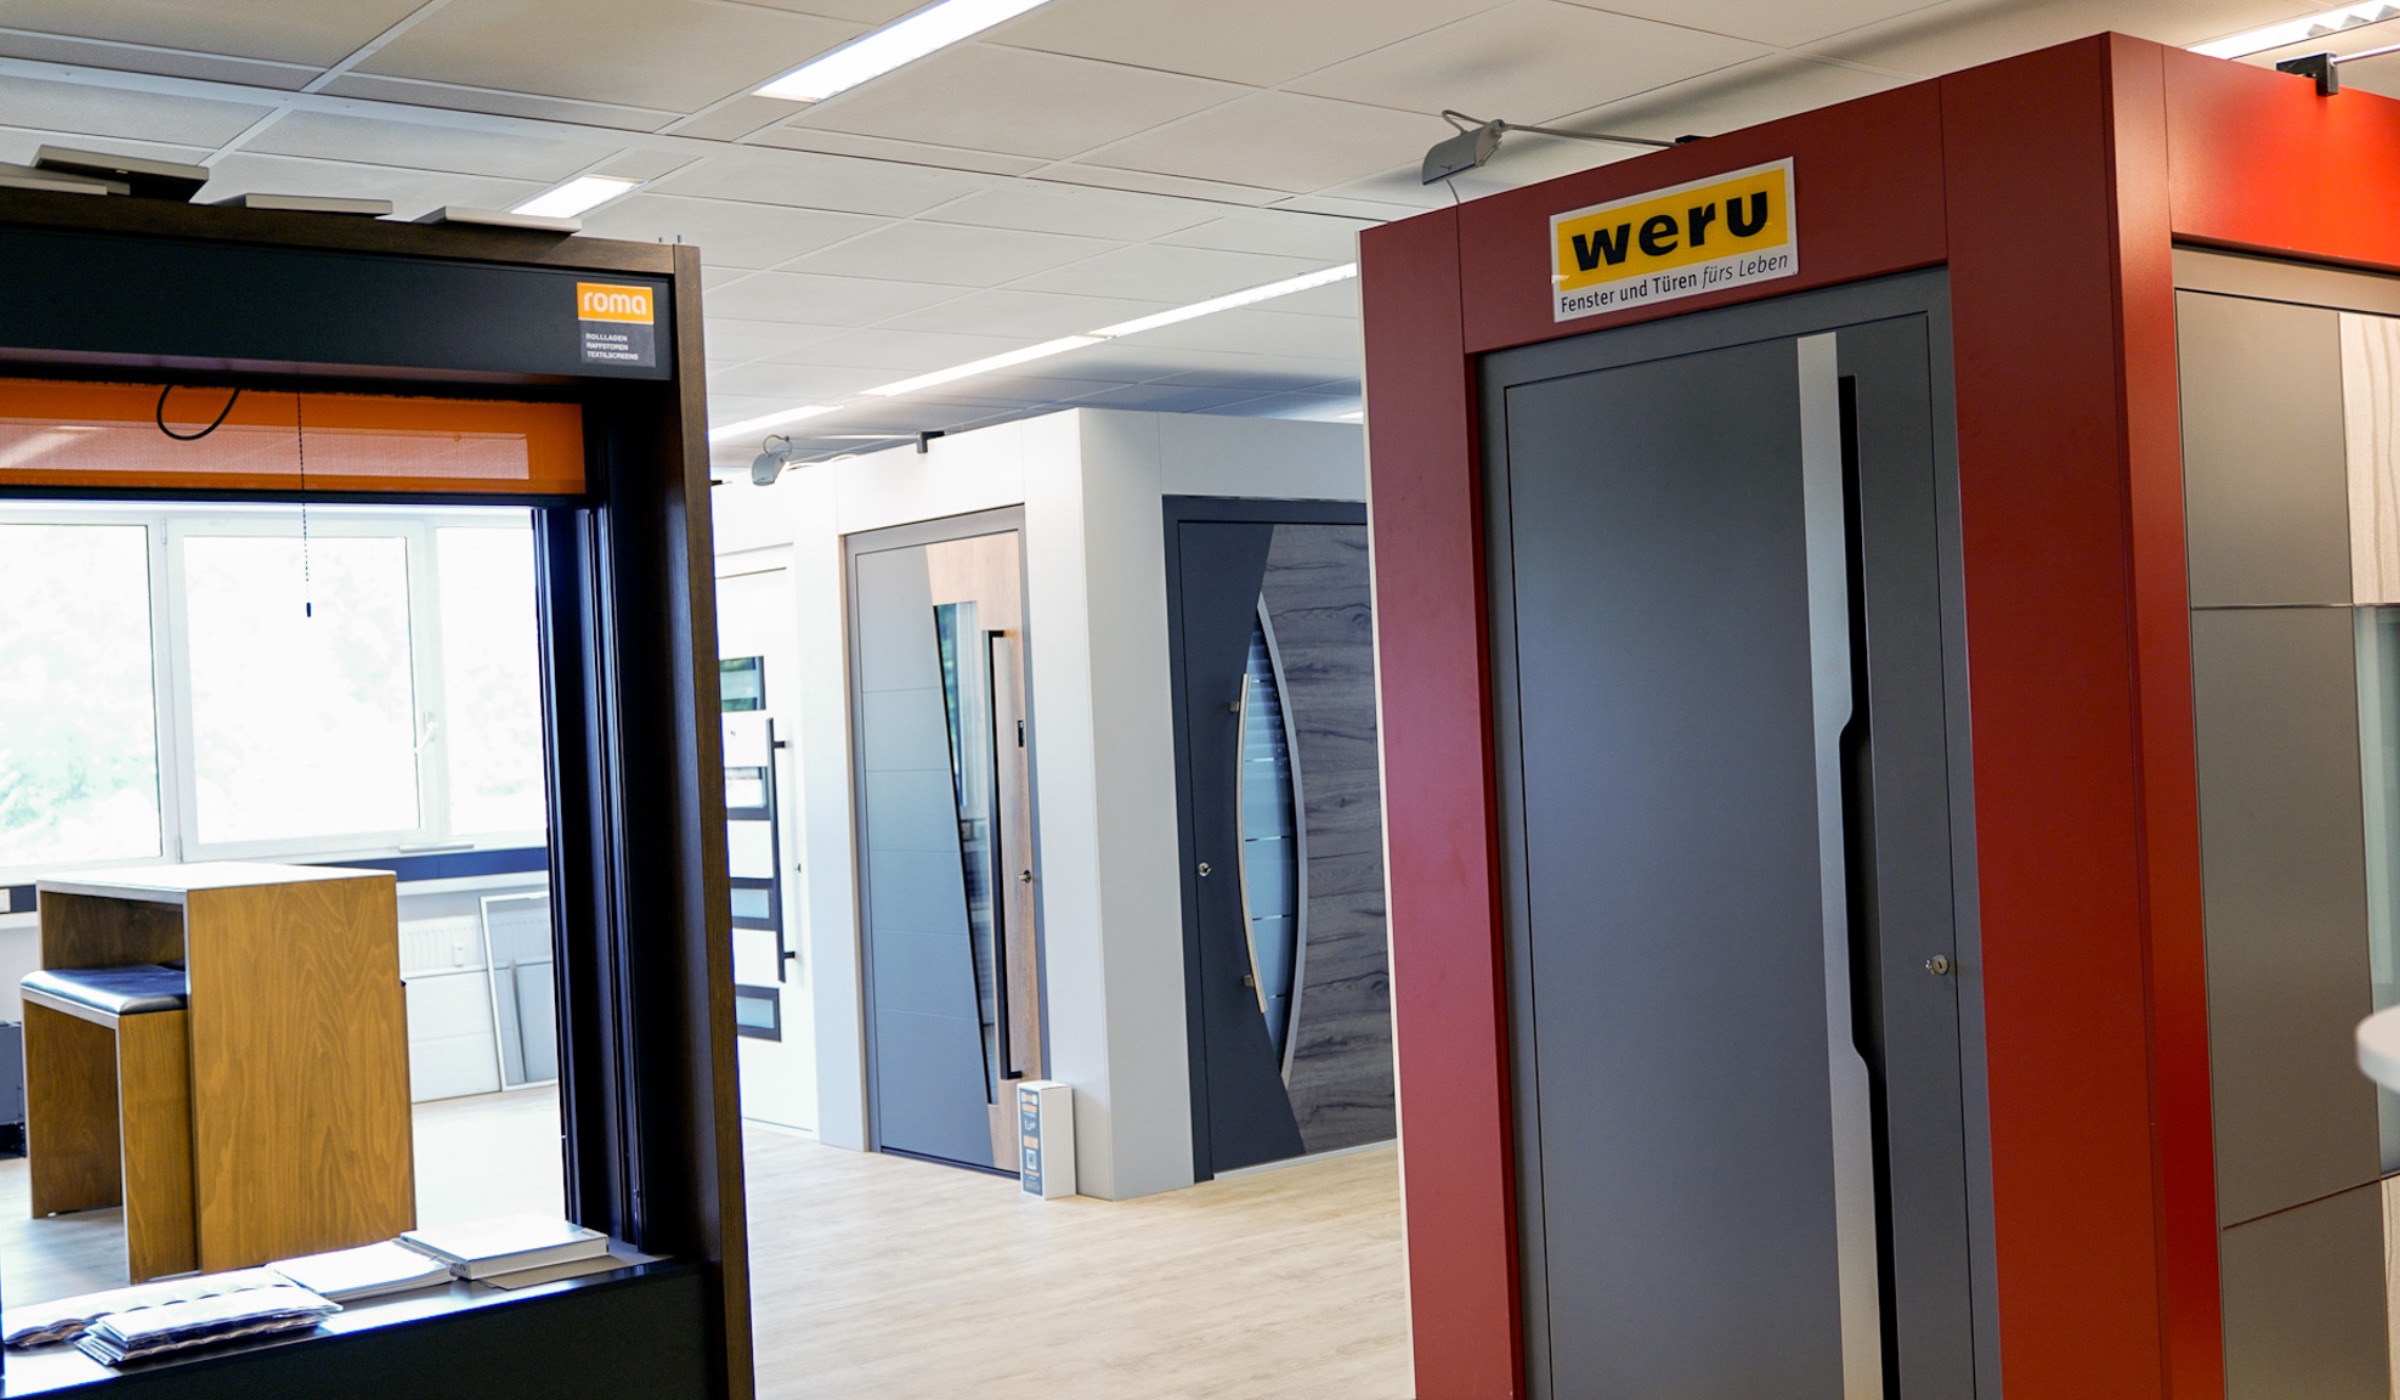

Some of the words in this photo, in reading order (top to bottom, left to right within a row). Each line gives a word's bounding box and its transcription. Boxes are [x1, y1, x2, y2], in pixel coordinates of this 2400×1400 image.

[1571, 191, 1768, 271] weru
[1561, 289, 1615, 313] Fenster
[1619, 279, 1648, 302] und
[1653, 272, 1697, 294] Türen
[1702, 265, 1733, 289] fürs
[1739, 253, 1787, 277] Leben
[583, 292, 647, 315] roma
[585, 333, 628, 342] ROLLLADEN
[586, 342, 629, 351] RAFFSTOREN
[587, 351, 639, 360] TEXTILSCREENS
